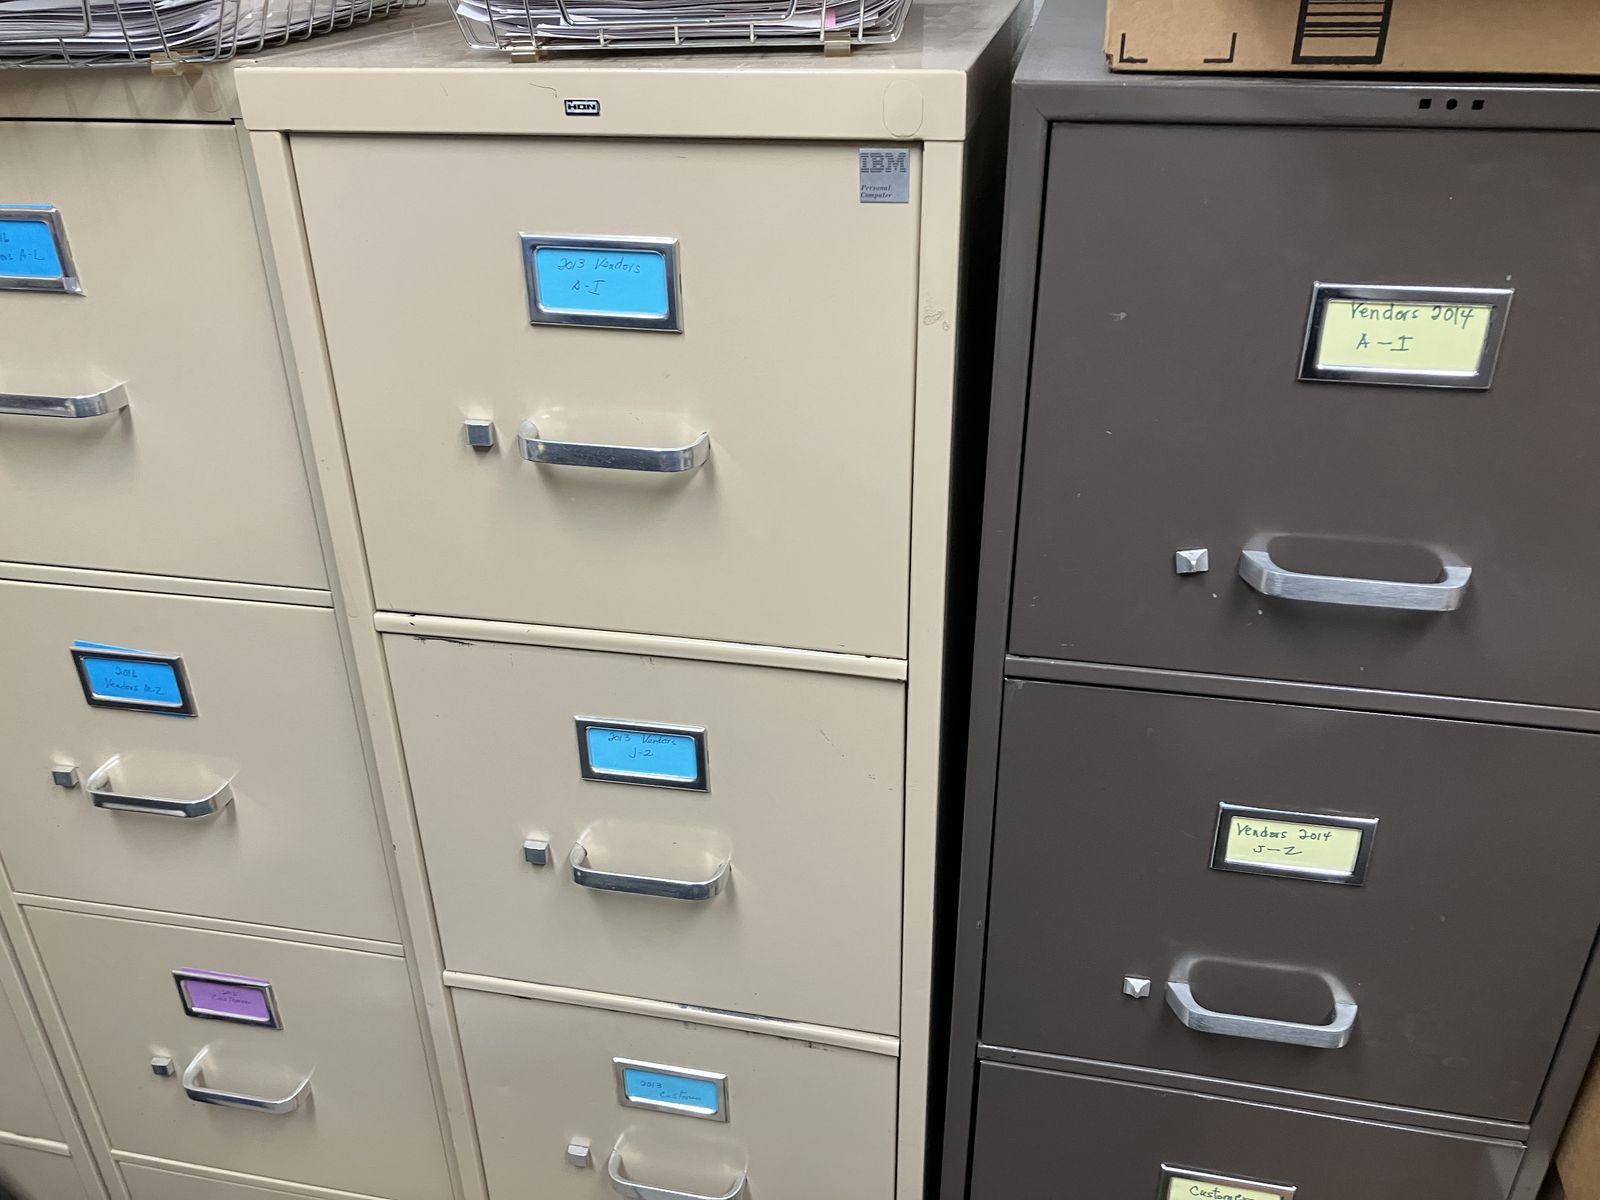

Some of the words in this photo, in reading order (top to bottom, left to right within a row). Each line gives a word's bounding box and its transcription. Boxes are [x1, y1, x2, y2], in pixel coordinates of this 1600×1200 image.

[567, 103, 596, 111] HON
[860, 152, 907, 174] IBM
[861, 184, 892, 192] Personal
[860, 192, 893, 200] Computer
[558, 257, 586, 271] 2013
[594, 256, 641, 274] Vendors
[1350, 302, 1420, 322] Vendors
[1431, 304, 1475, 330] 2014
[607, 732, 632, 742] 2013
[641, 735, 678, 746] Vendors
[1236, 822, 1288, 839] Vendors
[1299, 828, 1333, 841] 2014
[640, 1080, 663, 1089] 2013
